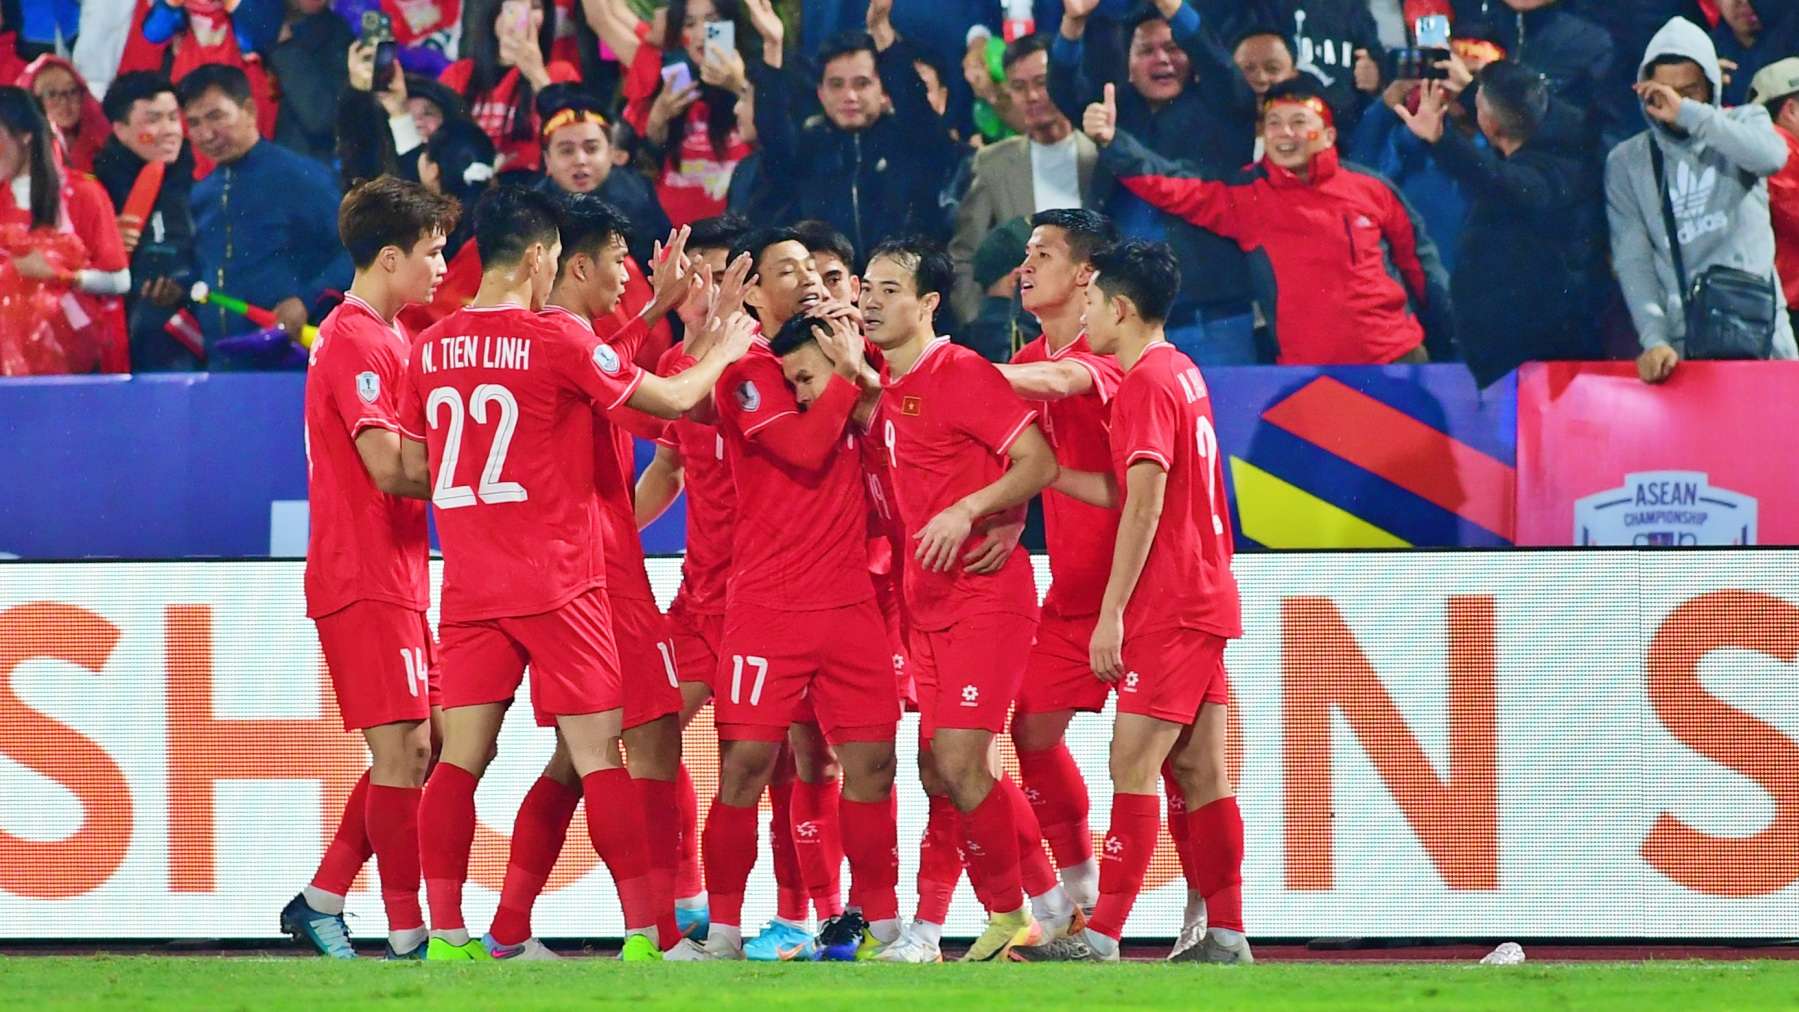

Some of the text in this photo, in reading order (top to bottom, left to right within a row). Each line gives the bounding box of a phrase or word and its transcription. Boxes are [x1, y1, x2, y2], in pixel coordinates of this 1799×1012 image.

[421, 336, 531, 374] N. TIEN LINH
[425, 383, 529, 510] 22
[883, 419, 897, 469] 9
[1623, 509, 1709, 528] CHAMPIONSHIP
[1635, 480, 1698, 507] ASEAN
[399, 647, 428, 697] 14
[730, 654, 769, 706] 17
